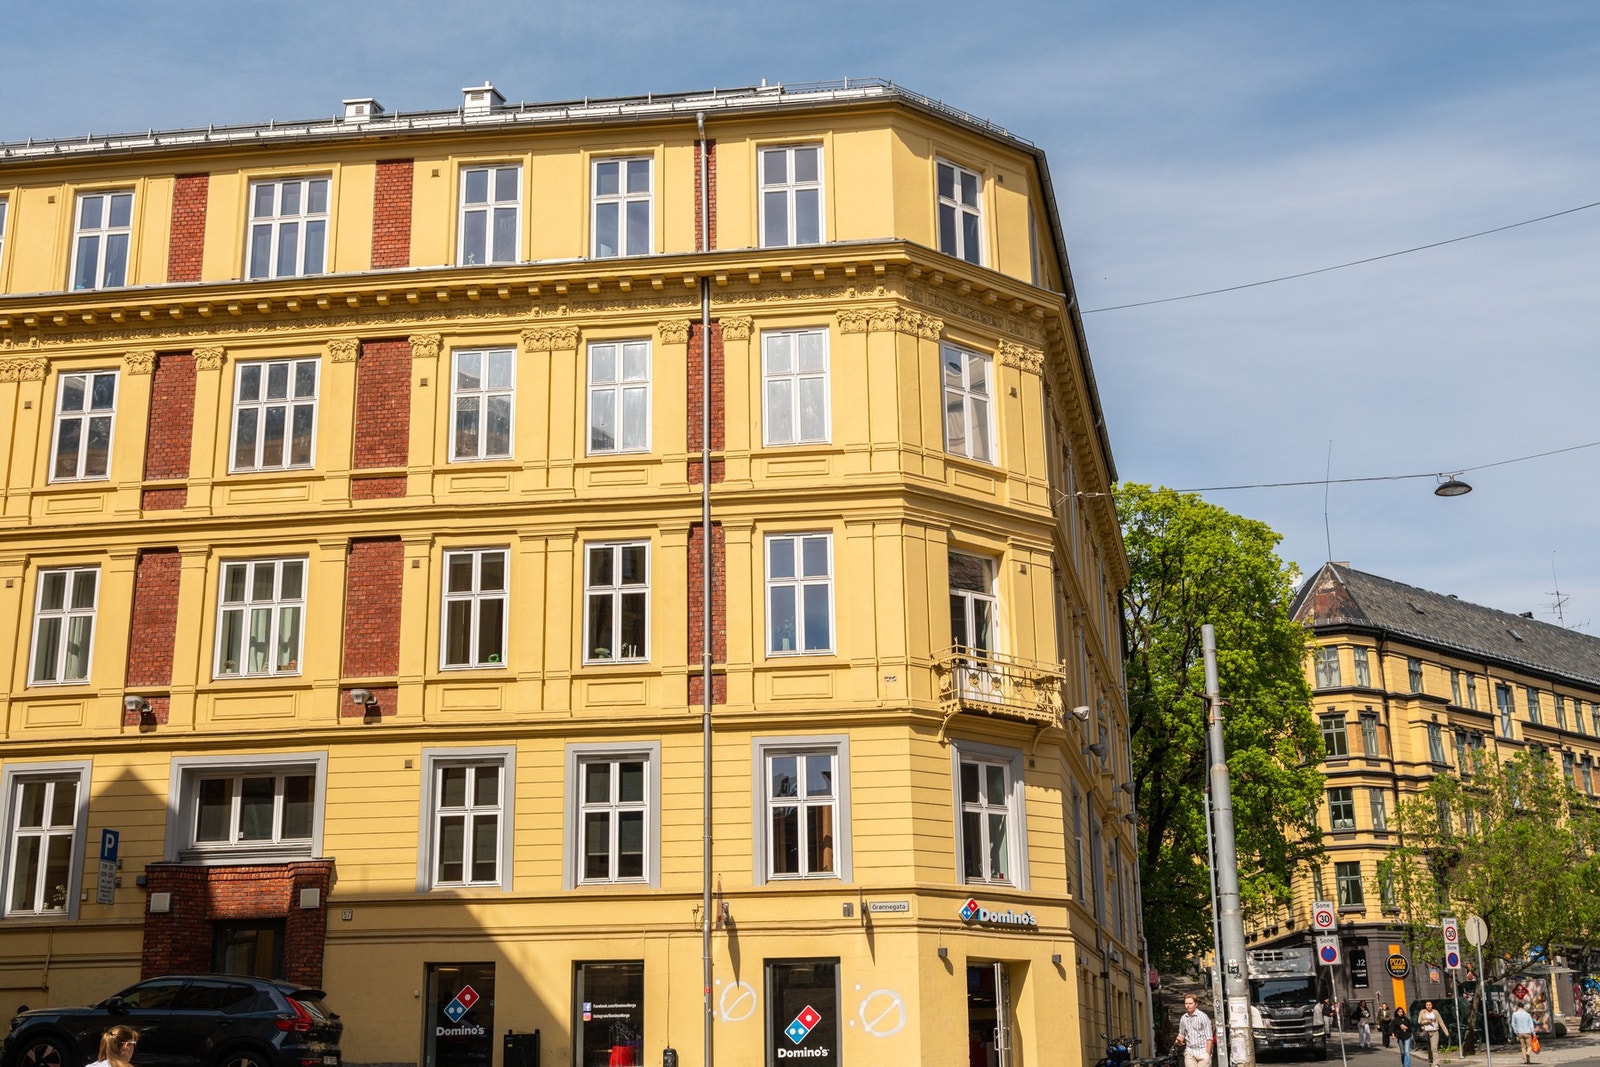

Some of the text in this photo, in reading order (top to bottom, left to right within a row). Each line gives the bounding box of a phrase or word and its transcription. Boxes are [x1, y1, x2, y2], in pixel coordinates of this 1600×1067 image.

[104, 833, 115, 857] P
[872, 904, 906, 912] Grønnegata
[978, 908, 1037, 925] Domino's
[1319, 914, 1330, 924] 30
[1447, 930, 1455, 938] 30
[1390, 958, 1406, 966] PIZZA
[436, 1025, 485, 1036] Domino's
[778, 1046, 829, 1058] Domino's
